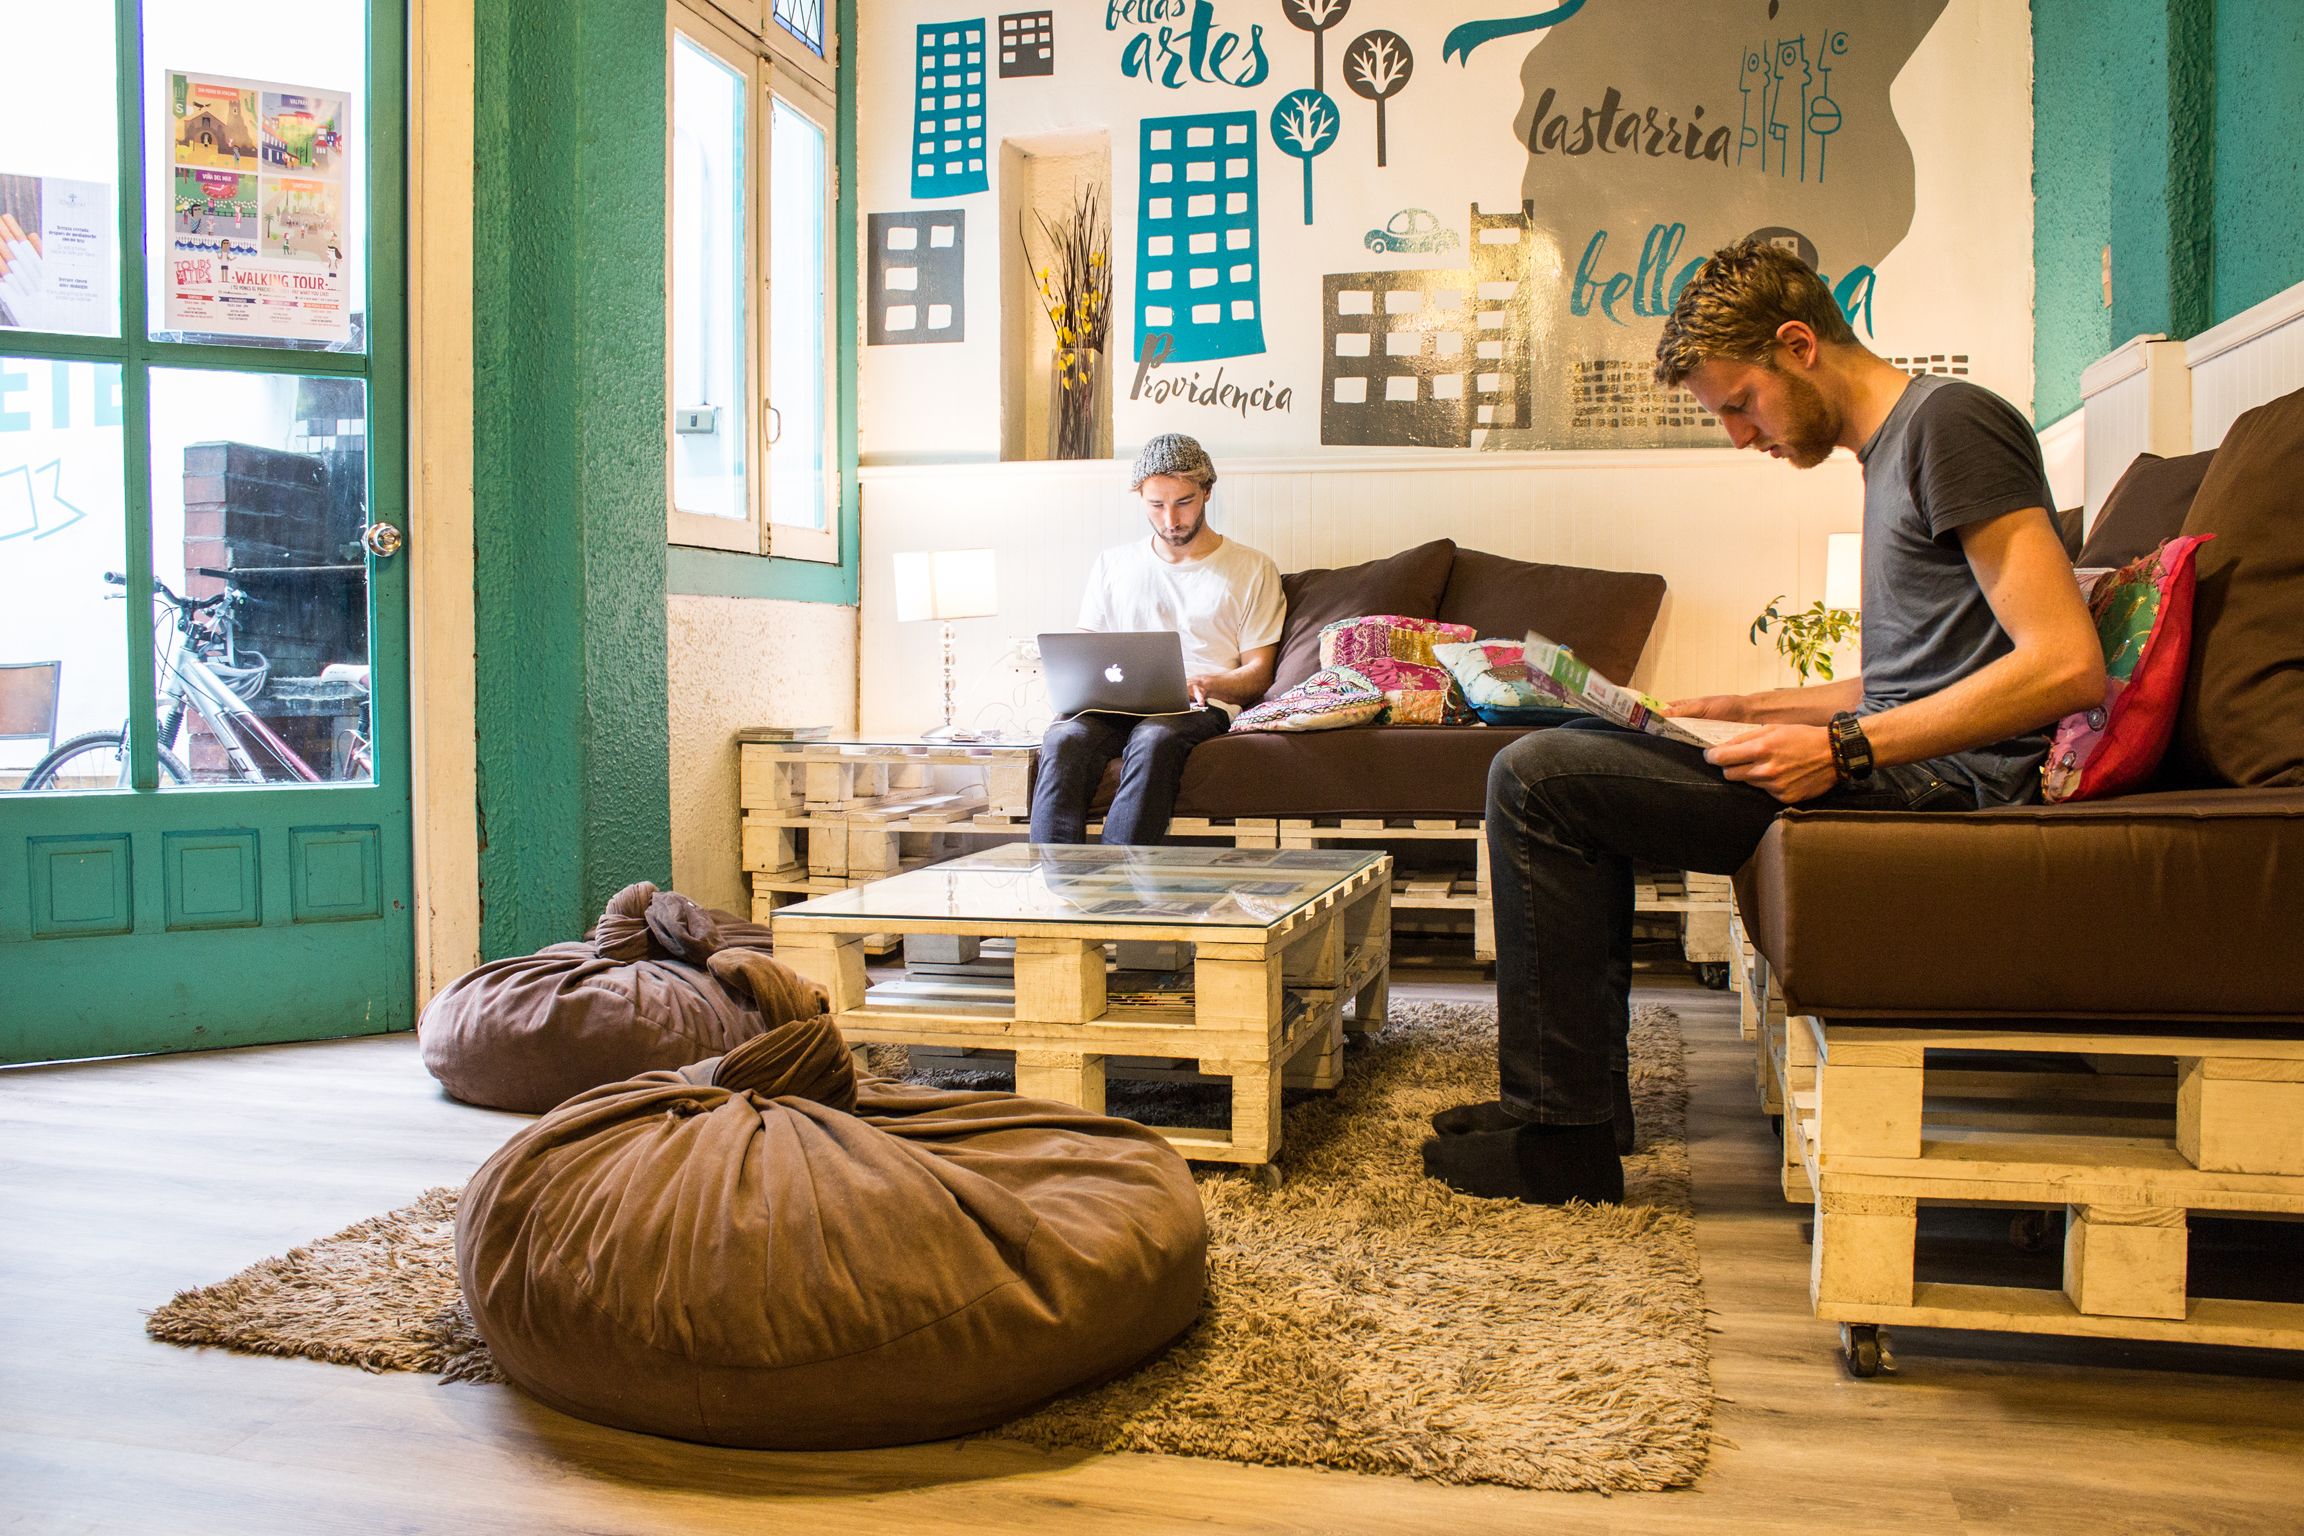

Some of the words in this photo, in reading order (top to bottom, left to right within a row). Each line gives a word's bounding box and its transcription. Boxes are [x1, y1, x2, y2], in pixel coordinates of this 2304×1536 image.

[1121, 0, 1270, 89] artes
[1527, 86, 1732, 168] lastarria
[174, 259, 211, 271] TOURS
[235, 271, 289, 288] WALKING
[293, 275, 325, 290] TOUR
[1129, 331, 1293, 419] Providencia
